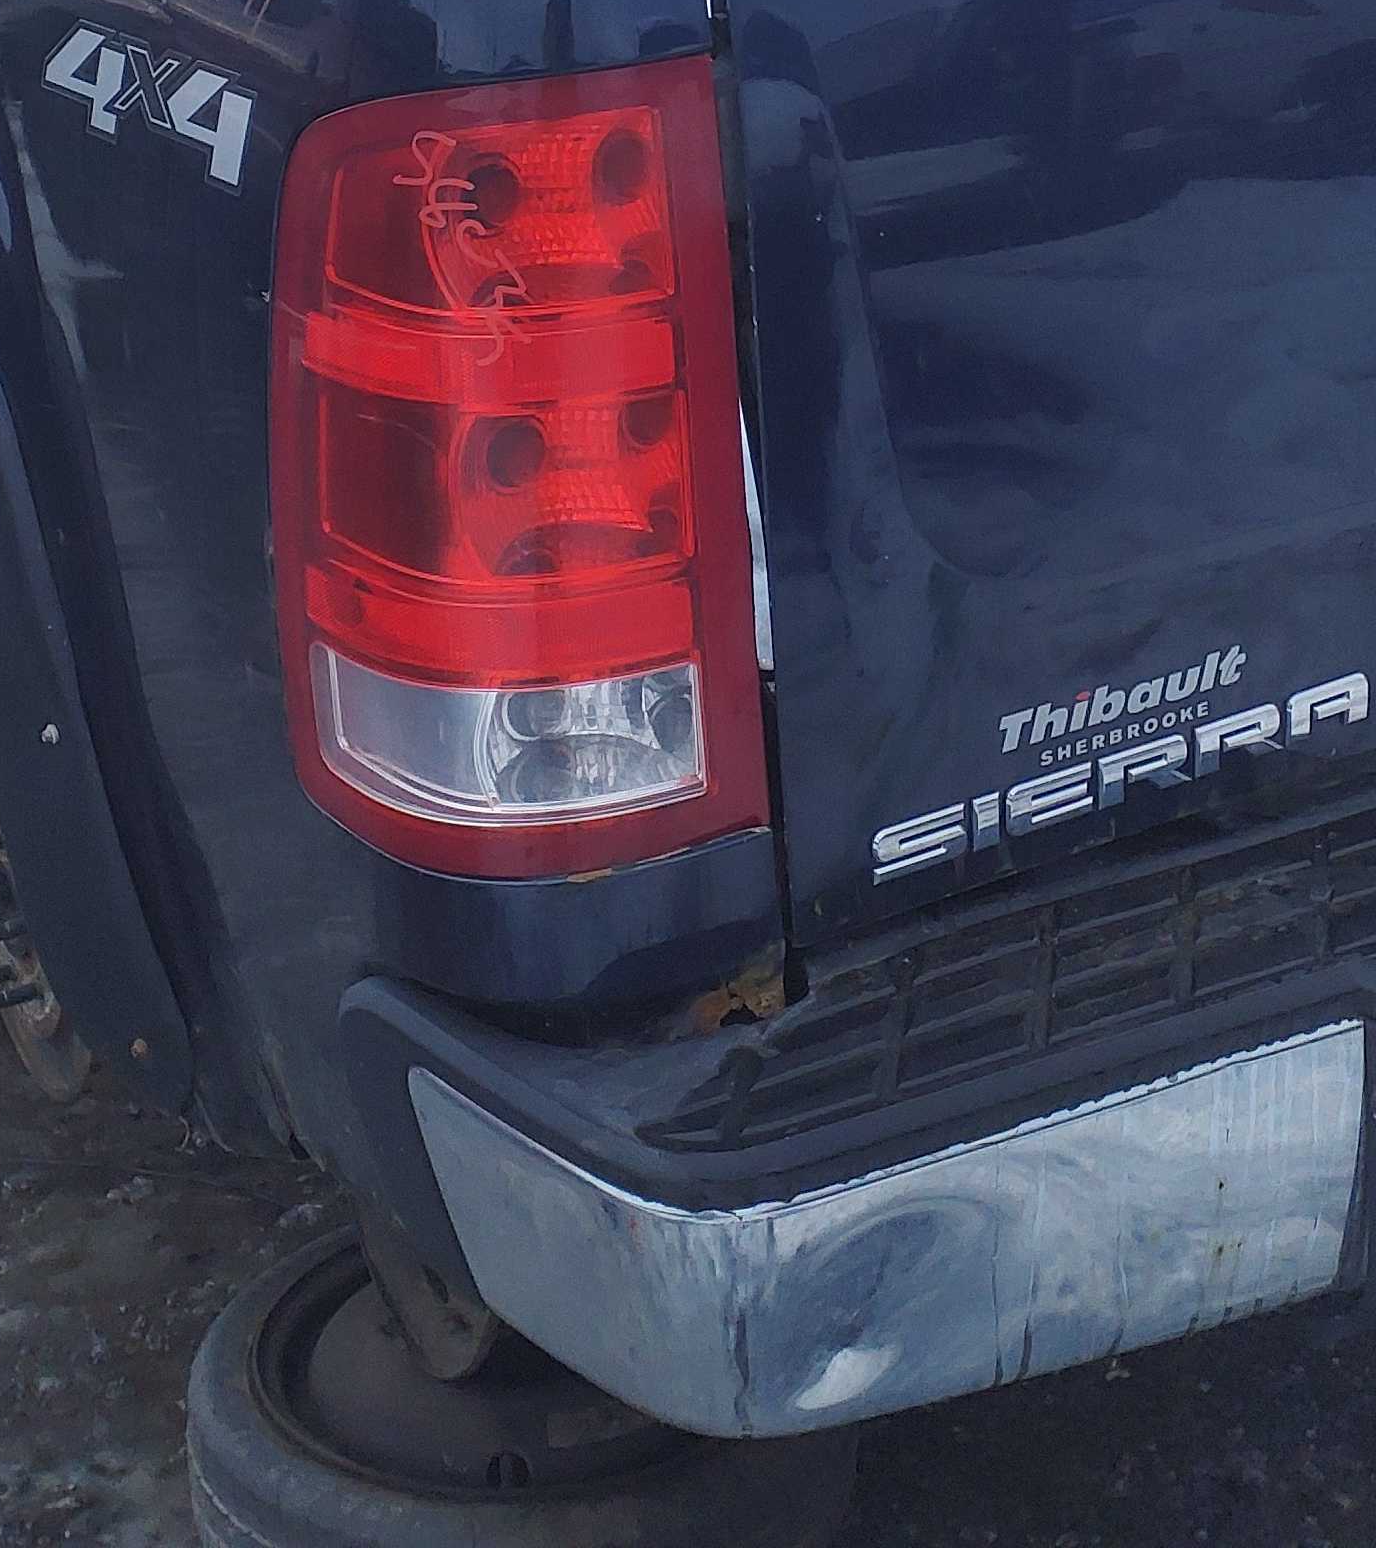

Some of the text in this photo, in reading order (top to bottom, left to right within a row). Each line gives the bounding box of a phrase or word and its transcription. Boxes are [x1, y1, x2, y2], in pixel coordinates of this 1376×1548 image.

[998, 644, 1248, 754] Thibault
[1039, 700, 1211, 767] SHERBROOKE
[871, 671, 1370, 886] SIERRA
